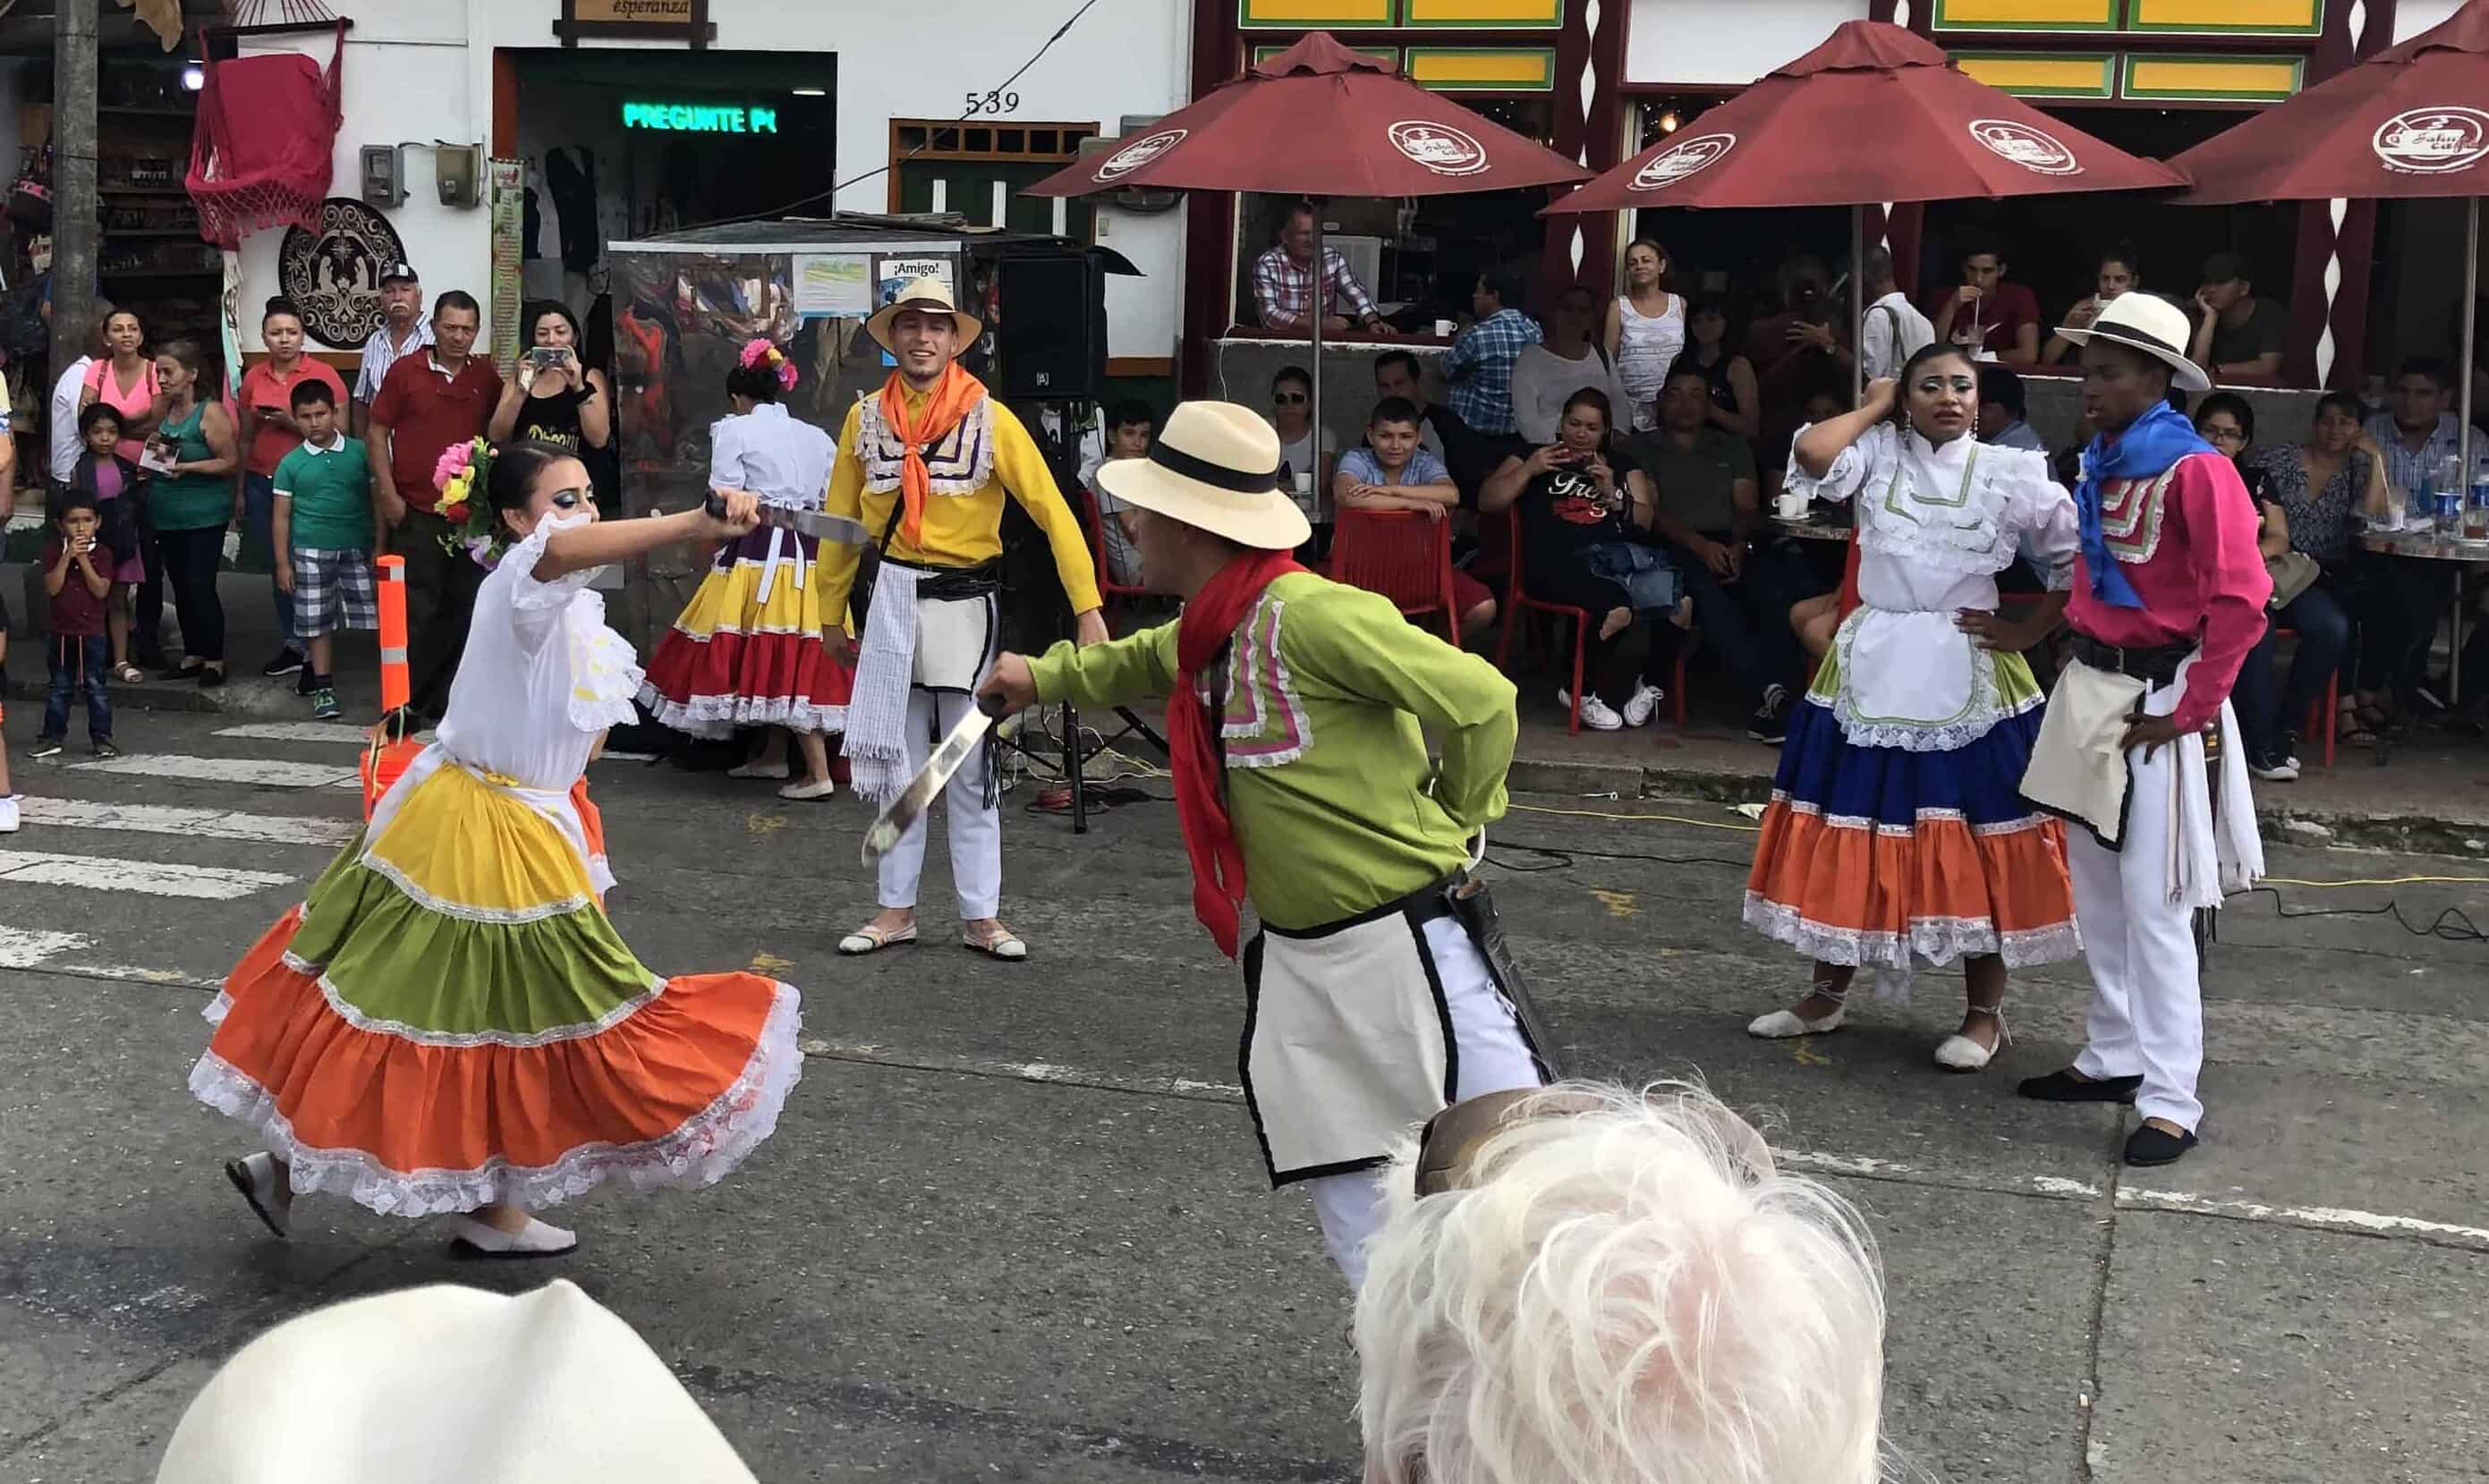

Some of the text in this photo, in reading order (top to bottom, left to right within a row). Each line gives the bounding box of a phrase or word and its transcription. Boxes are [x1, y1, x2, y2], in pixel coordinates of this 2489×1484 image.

[613, 0, 688, 19] esperanza
[966, 91, 1019, 114] 539
[623, 102, 746, 133] PREGUNTE
[894, 262, 939, 277] ¡Amigo!
[1548, 471, 1600, 499] Fre
